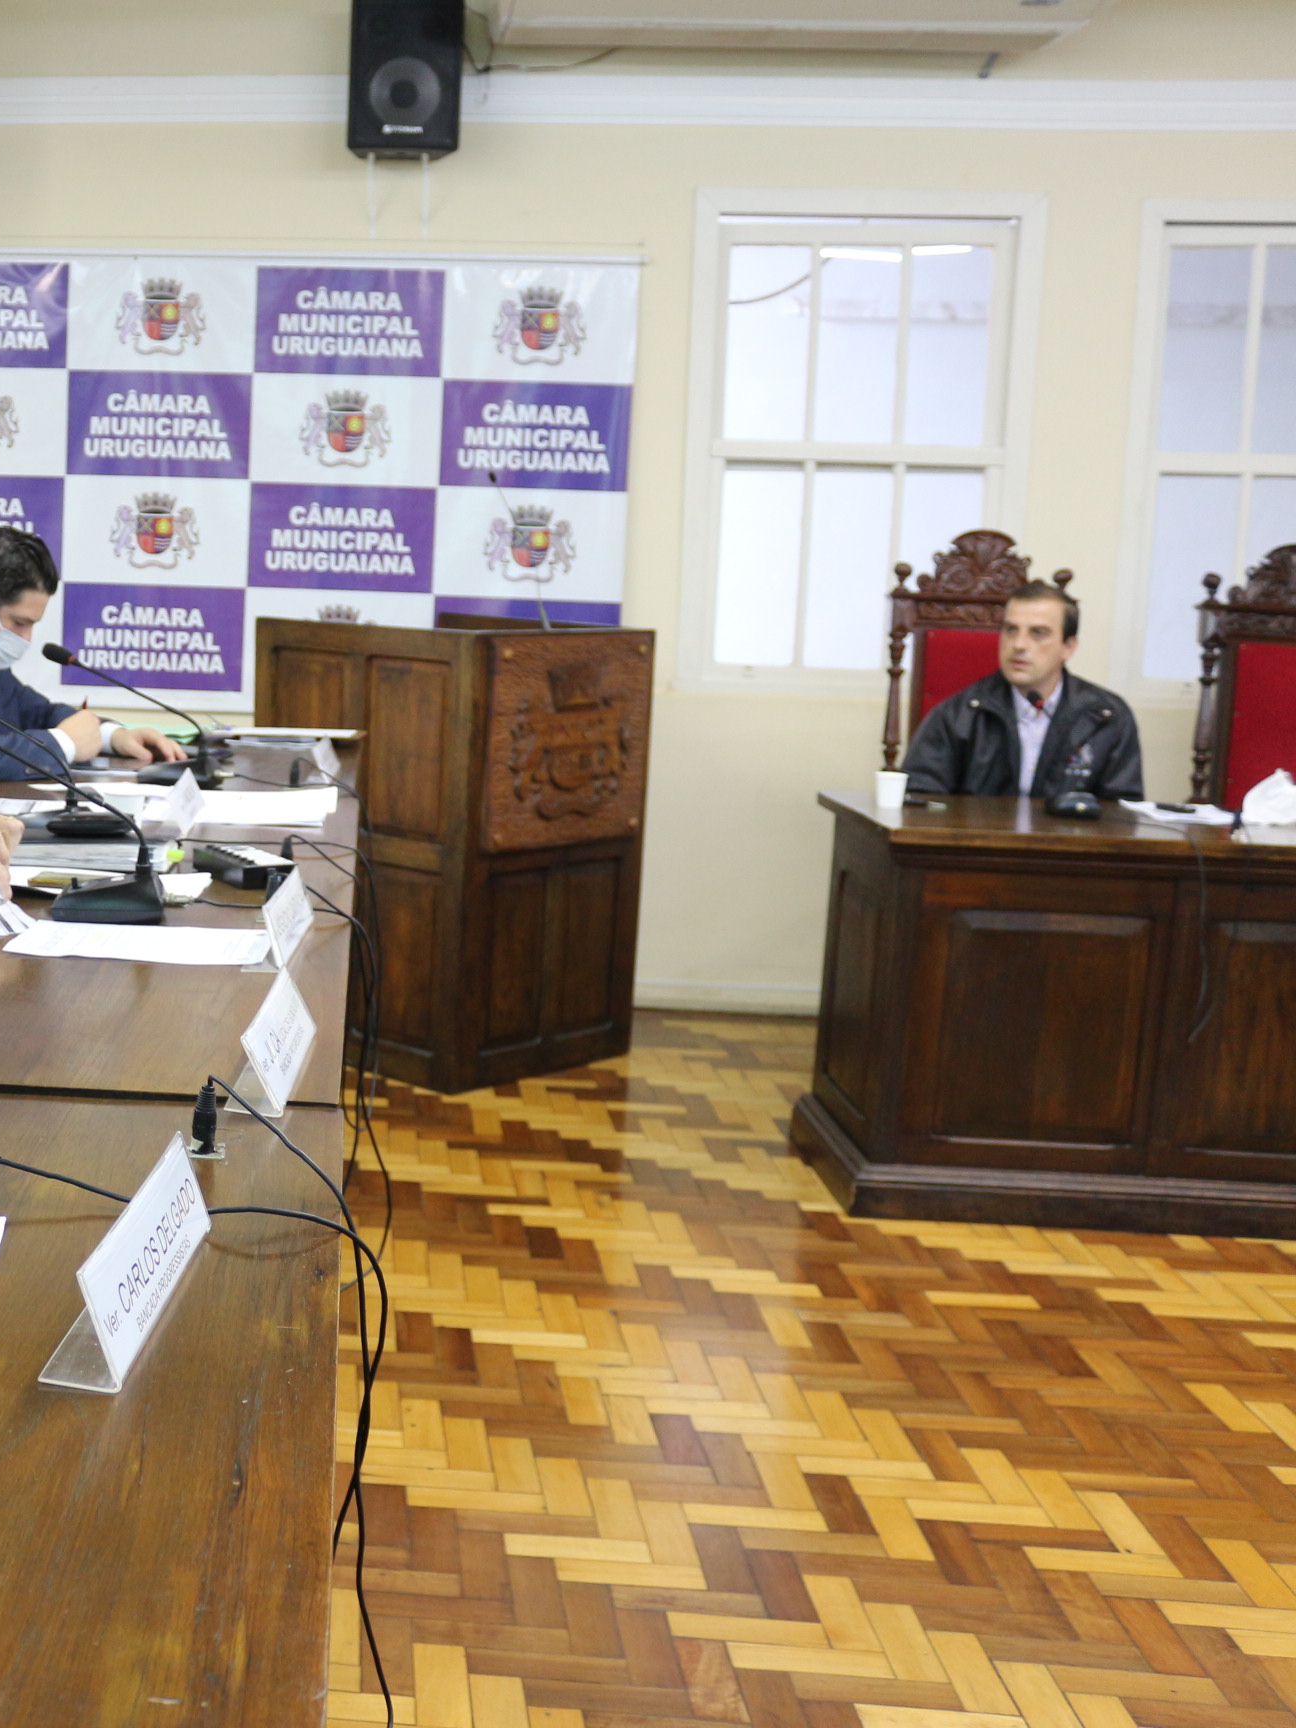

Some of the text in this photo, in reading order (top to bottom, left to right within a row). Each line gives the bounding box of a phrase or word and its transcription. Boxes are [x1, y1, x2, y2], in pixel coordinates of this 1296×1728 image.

[296, 286, 403, 312] CÂMARA
[278, 313, 419, 336] MUNICIPAL
[272, 335, 423, 358] URUGUAIANA
[107, 389, 211, 415] CÂMARA
[482, 399, 590, 427] CÂMARA
[90, 416, 227, 438] MUNICIPAL
[464, 426, 606, 450] MUNICIPAL
[84, 438, 232, 460] URUGUAIANA
[457, 448, 610, 474] URUGUAIANA
[289, 502, 395, 528] CÂMARA
[271, 528, 411, 553] MUNICIPAL
[265, 550, 415, 576] URUGUAIANA
[101, 602, 204, 628] CÂMARA
[84, 628, 221, 652] MUNICIPAL
[78, 649, 225, 674] URUGUAIANA
[104, 1178, 196, 1337] Ver. CARLOS DELGADO
[136, 1235, 191, 1332] BANCADA PROGRESSISTAS
